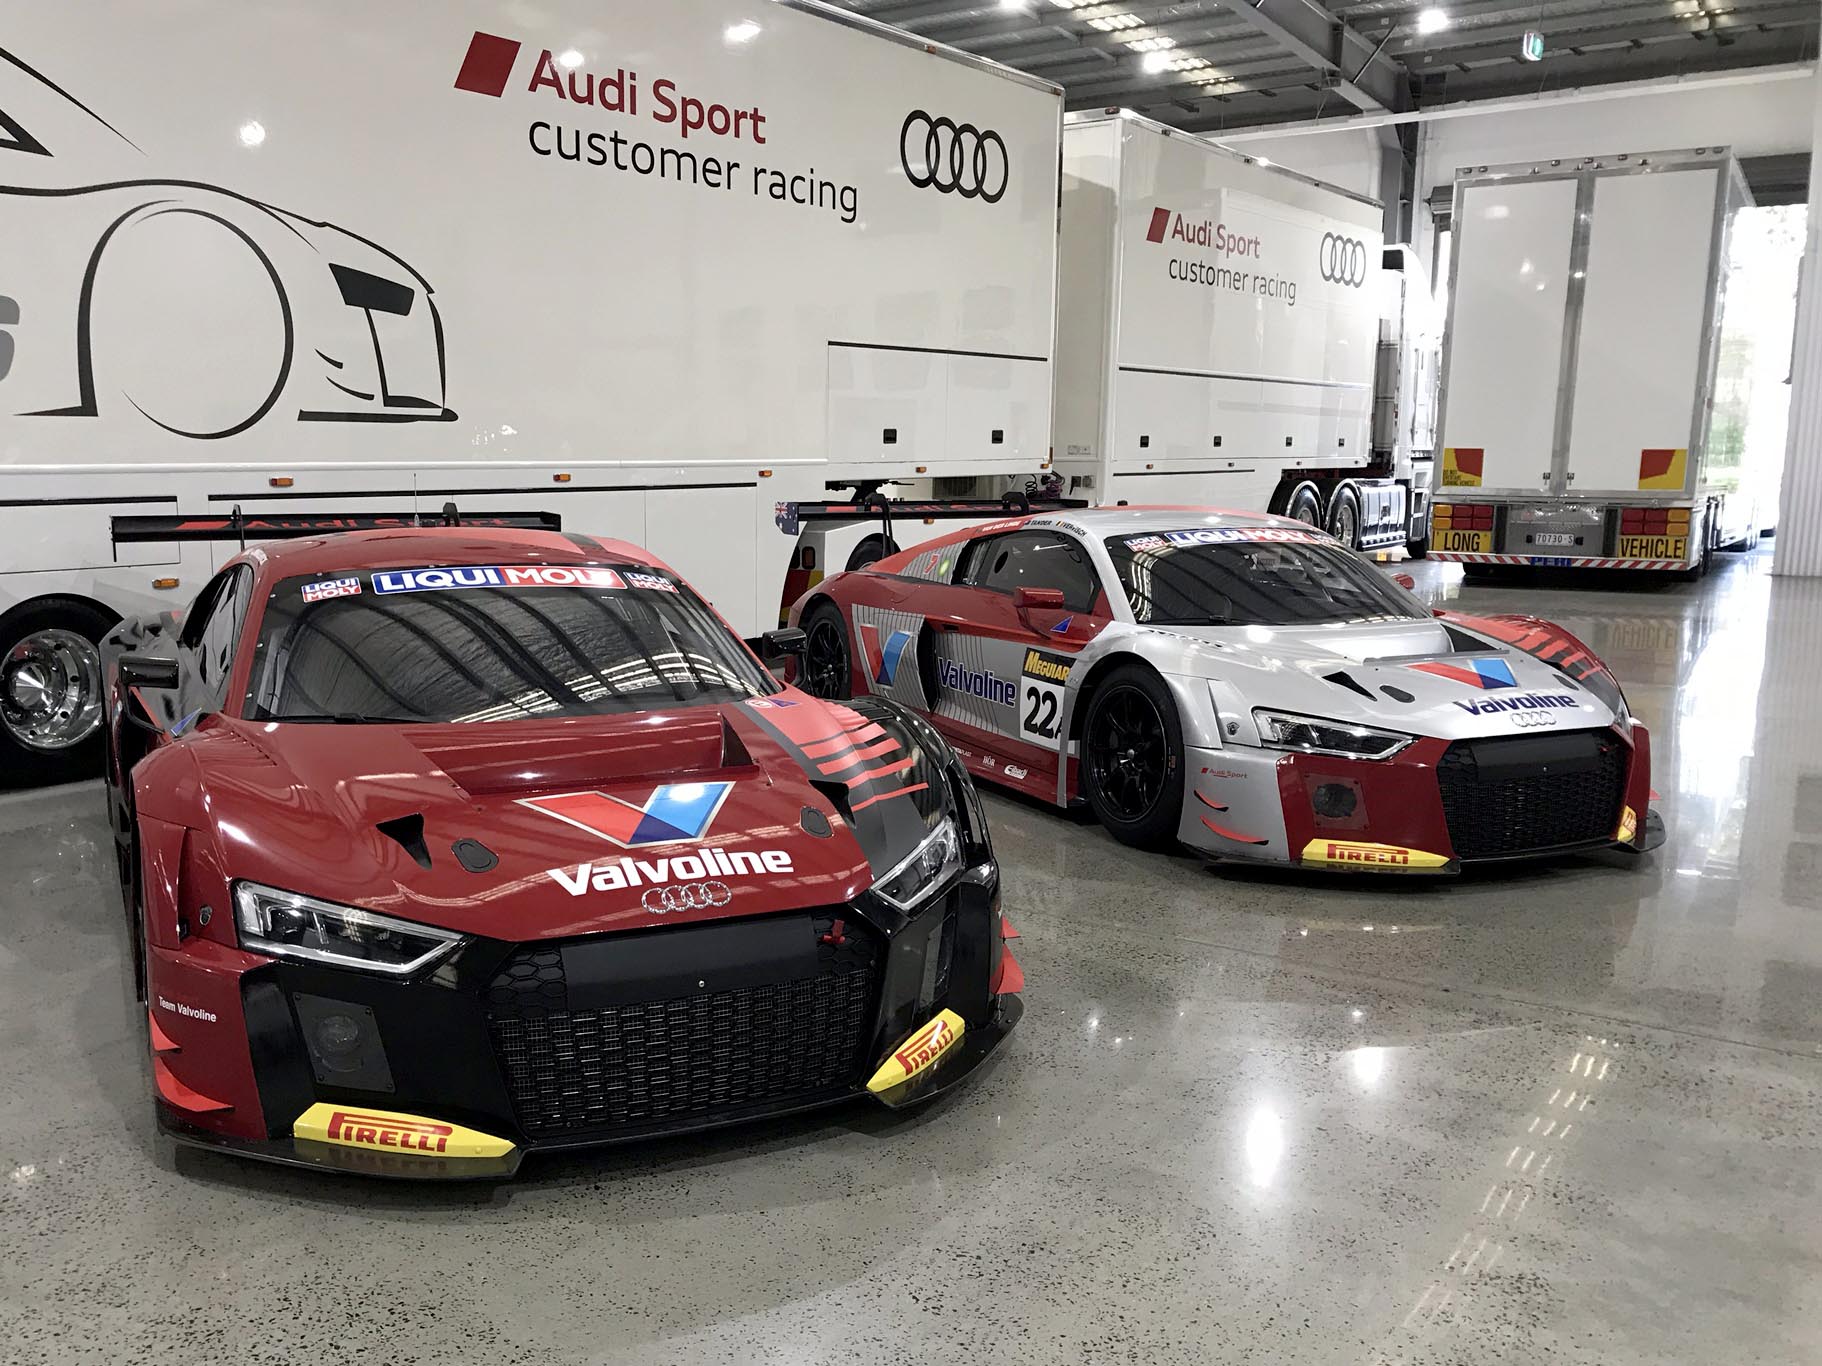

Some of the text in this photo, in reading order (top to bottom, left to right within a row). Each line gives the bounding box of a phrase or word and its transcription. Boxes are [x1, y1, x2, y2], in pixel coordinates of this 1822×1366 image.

[528, 50, 766, 145] Audi Sport
[529, 120, 858, 223] customer racing
[1171, 213, 1260, 259] Audi Sport
[1169, 258, 1297, 306] customer racing
[1443, 531, 1480, 552] LONG
[1620, 537, 1682, 559] VEHICLE
[304, 577, 357, 593] LIQUI
[380, 568, 500, 592] LIQUI
[626, 572, 670, 585] LIQUI
[632, 580, 675, 593] MOLY
[307, 586, 359, 601] MOLY
[938, 657, 1016, 708] Valvoline
[1453, 693, 1579, 716] Valvoline
[1327, 843, 1409, 865] PIRELLI
[546, 848, 794, 897] Valvoline
[158, 995, 217, 1022] Team Valvoline
[895, 1019, 955, 1076] PIRELLI
[327, 1111, 453, 1153] PIRELLI
